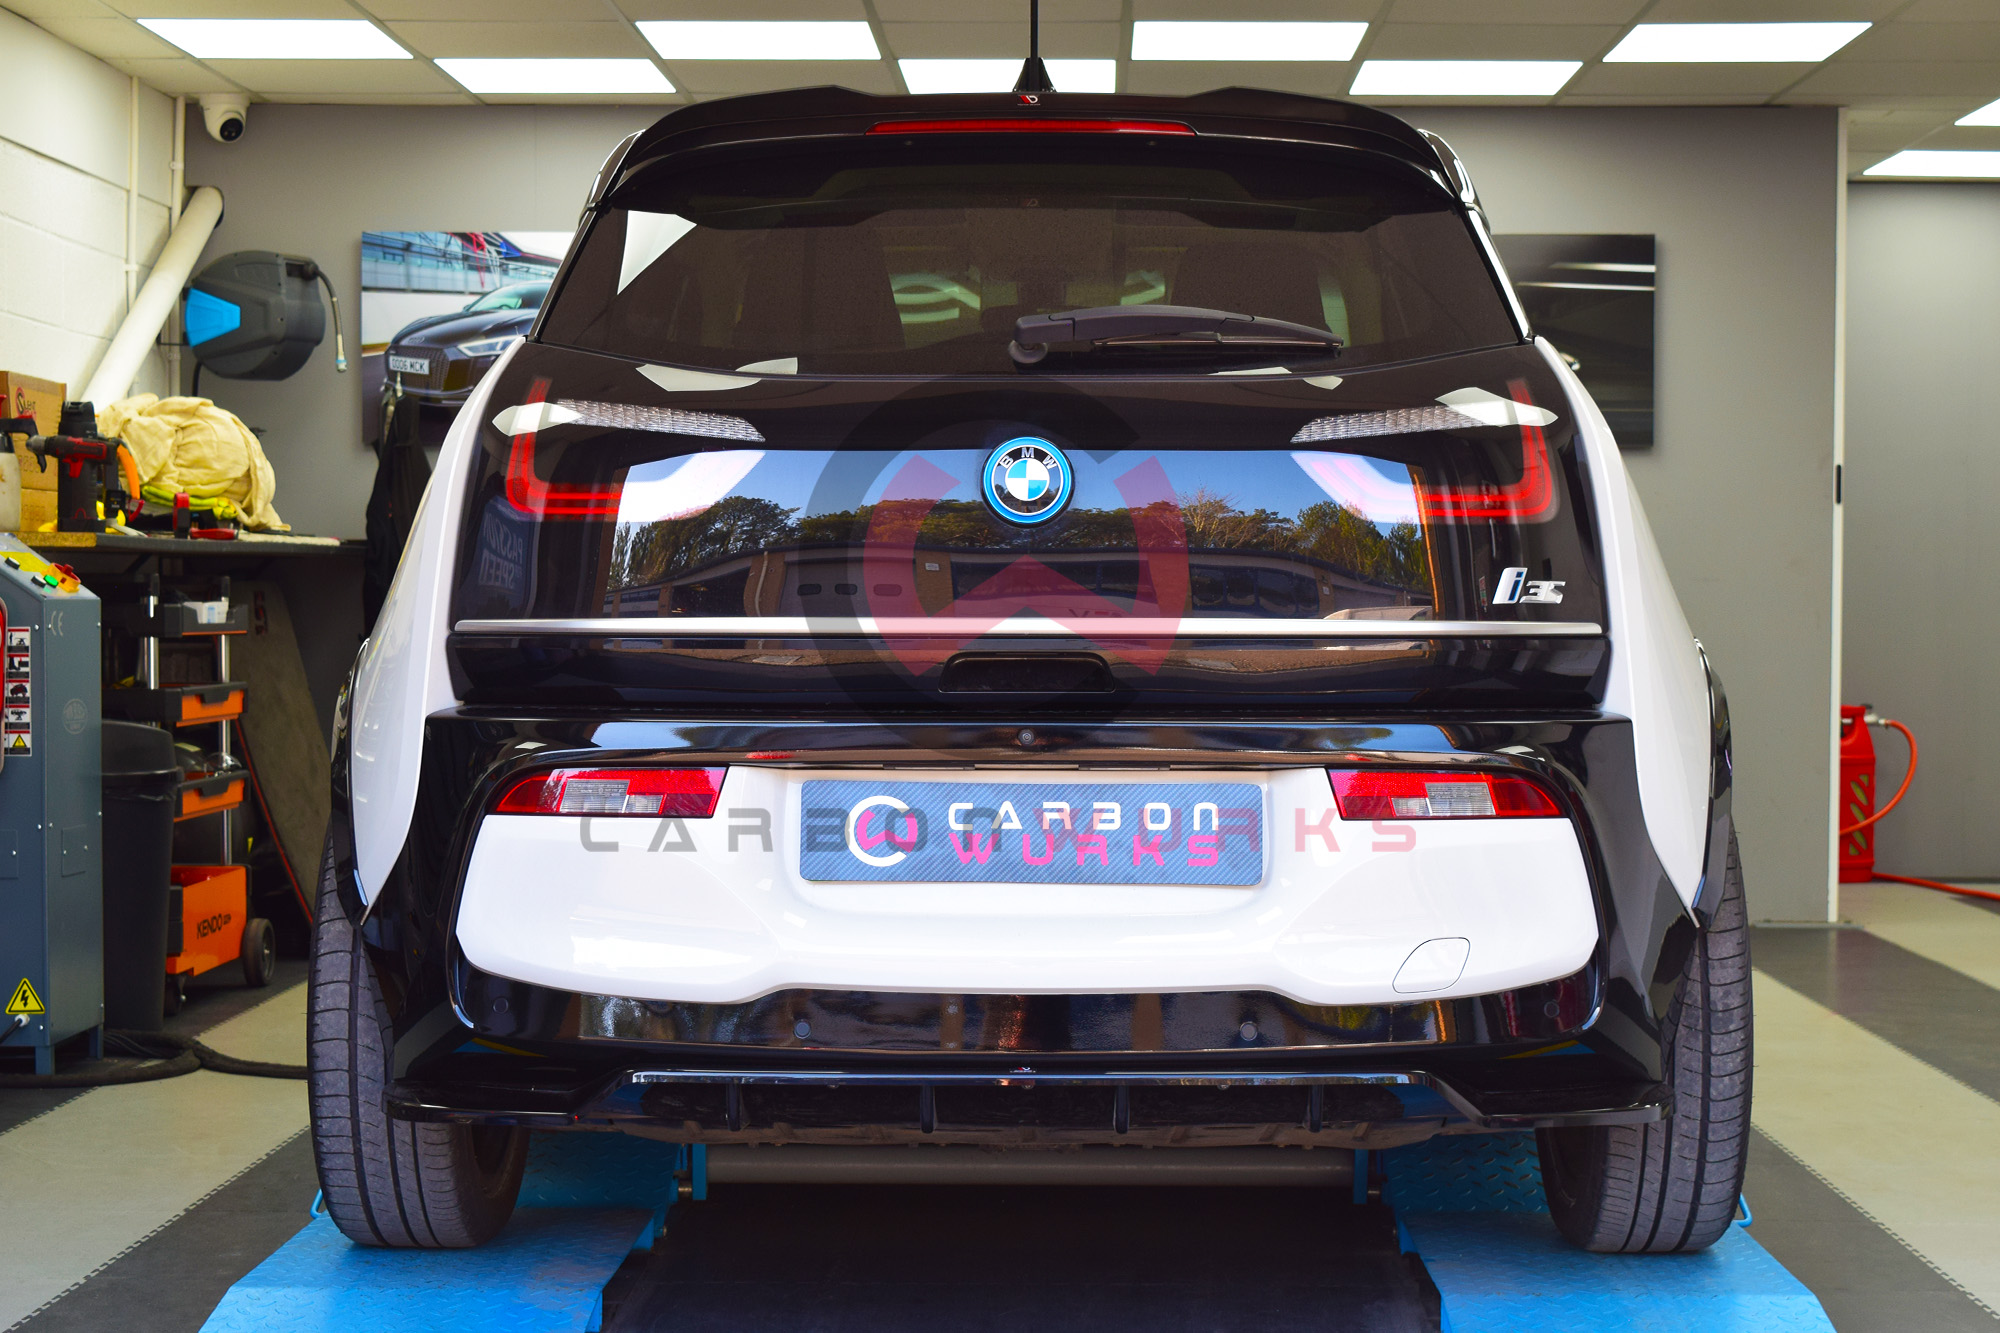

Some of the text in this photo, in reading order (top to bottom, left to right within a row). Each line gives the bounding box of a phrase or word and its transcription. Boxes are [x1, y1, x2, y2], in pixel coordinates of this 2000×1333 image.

[999, 447, 1057, 469] BMW
[1492, 567, 1566, 605] i3s
[948, 801, 1219, 832] CARBON
[948, 833, 1219, 867] WURKS
[196, 913, 223, 940] KENDO
